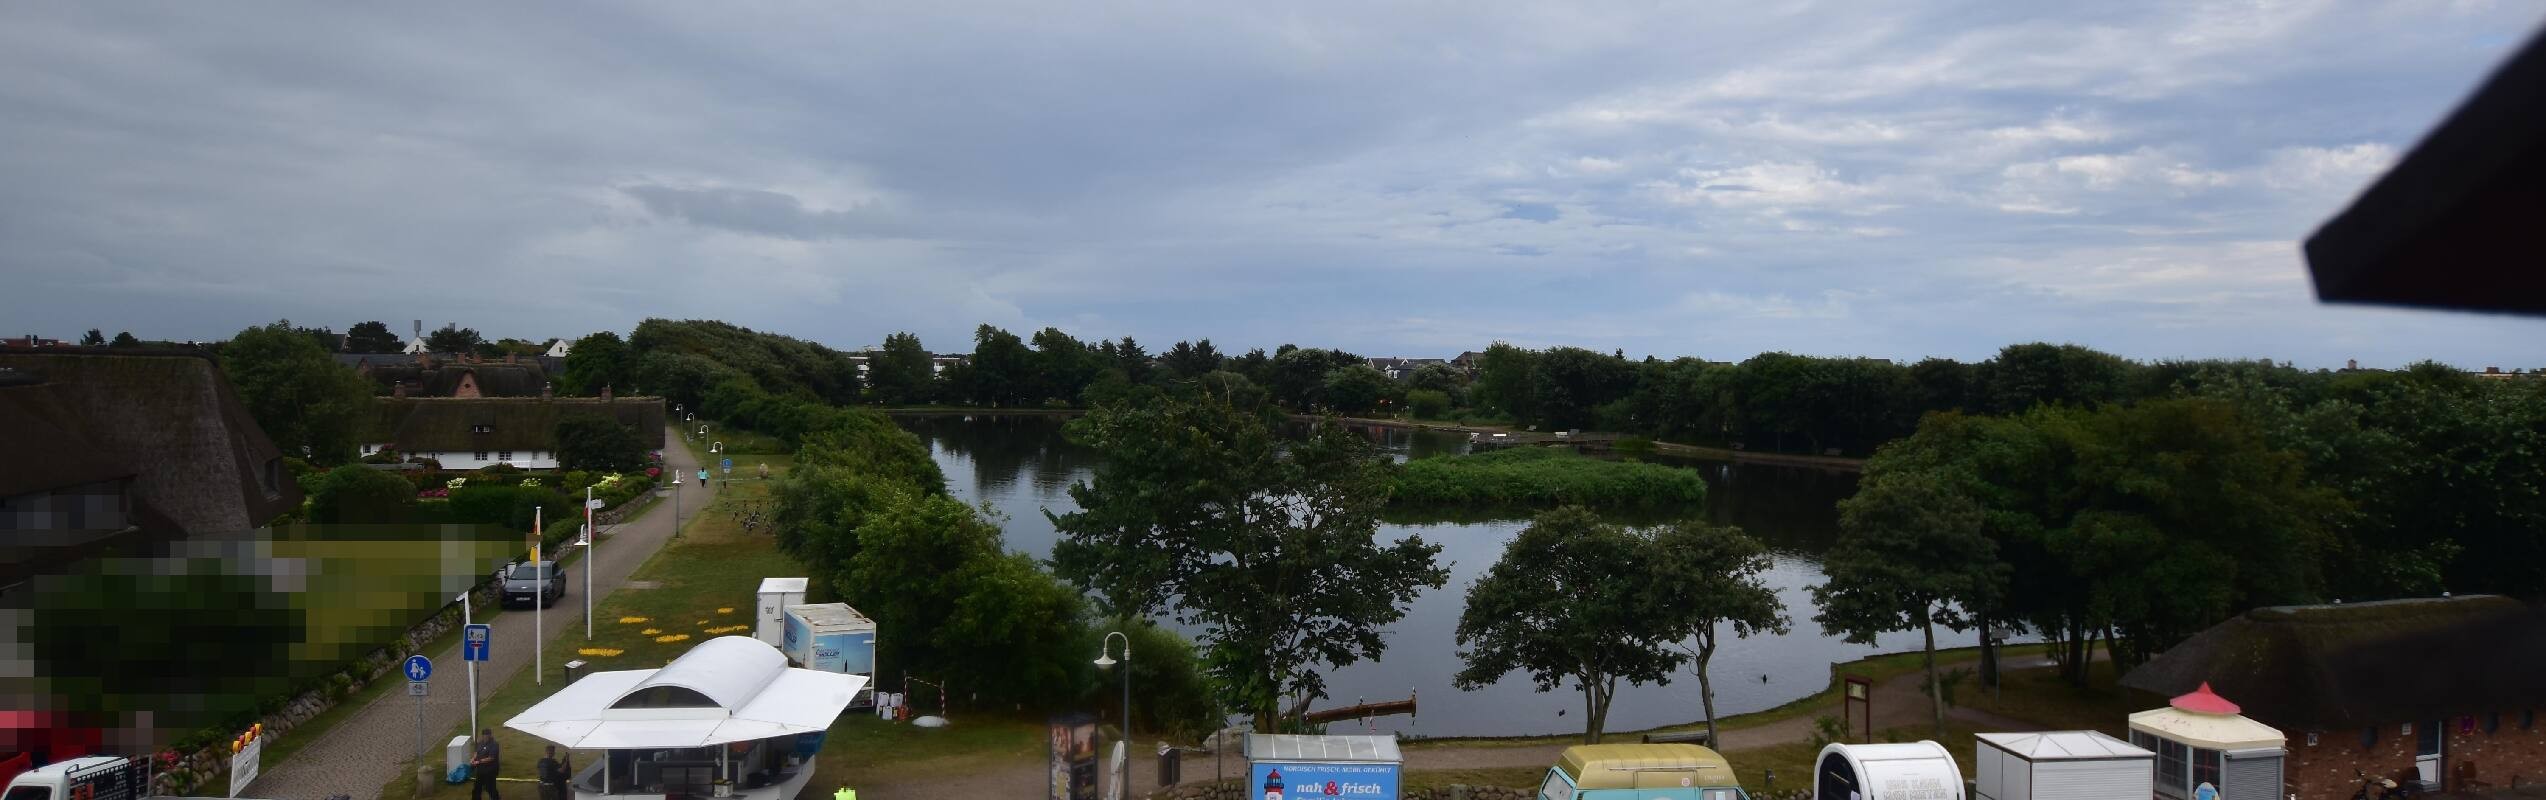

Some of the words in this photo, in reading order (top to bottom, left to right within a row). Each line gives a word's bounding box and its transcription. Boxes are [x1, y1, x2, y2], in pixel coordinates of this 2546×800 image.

[1296, 782, 1323, 793] nah
[1323, 780, 1339, 796] &
[1339, 782, 1381, 796] frisch
